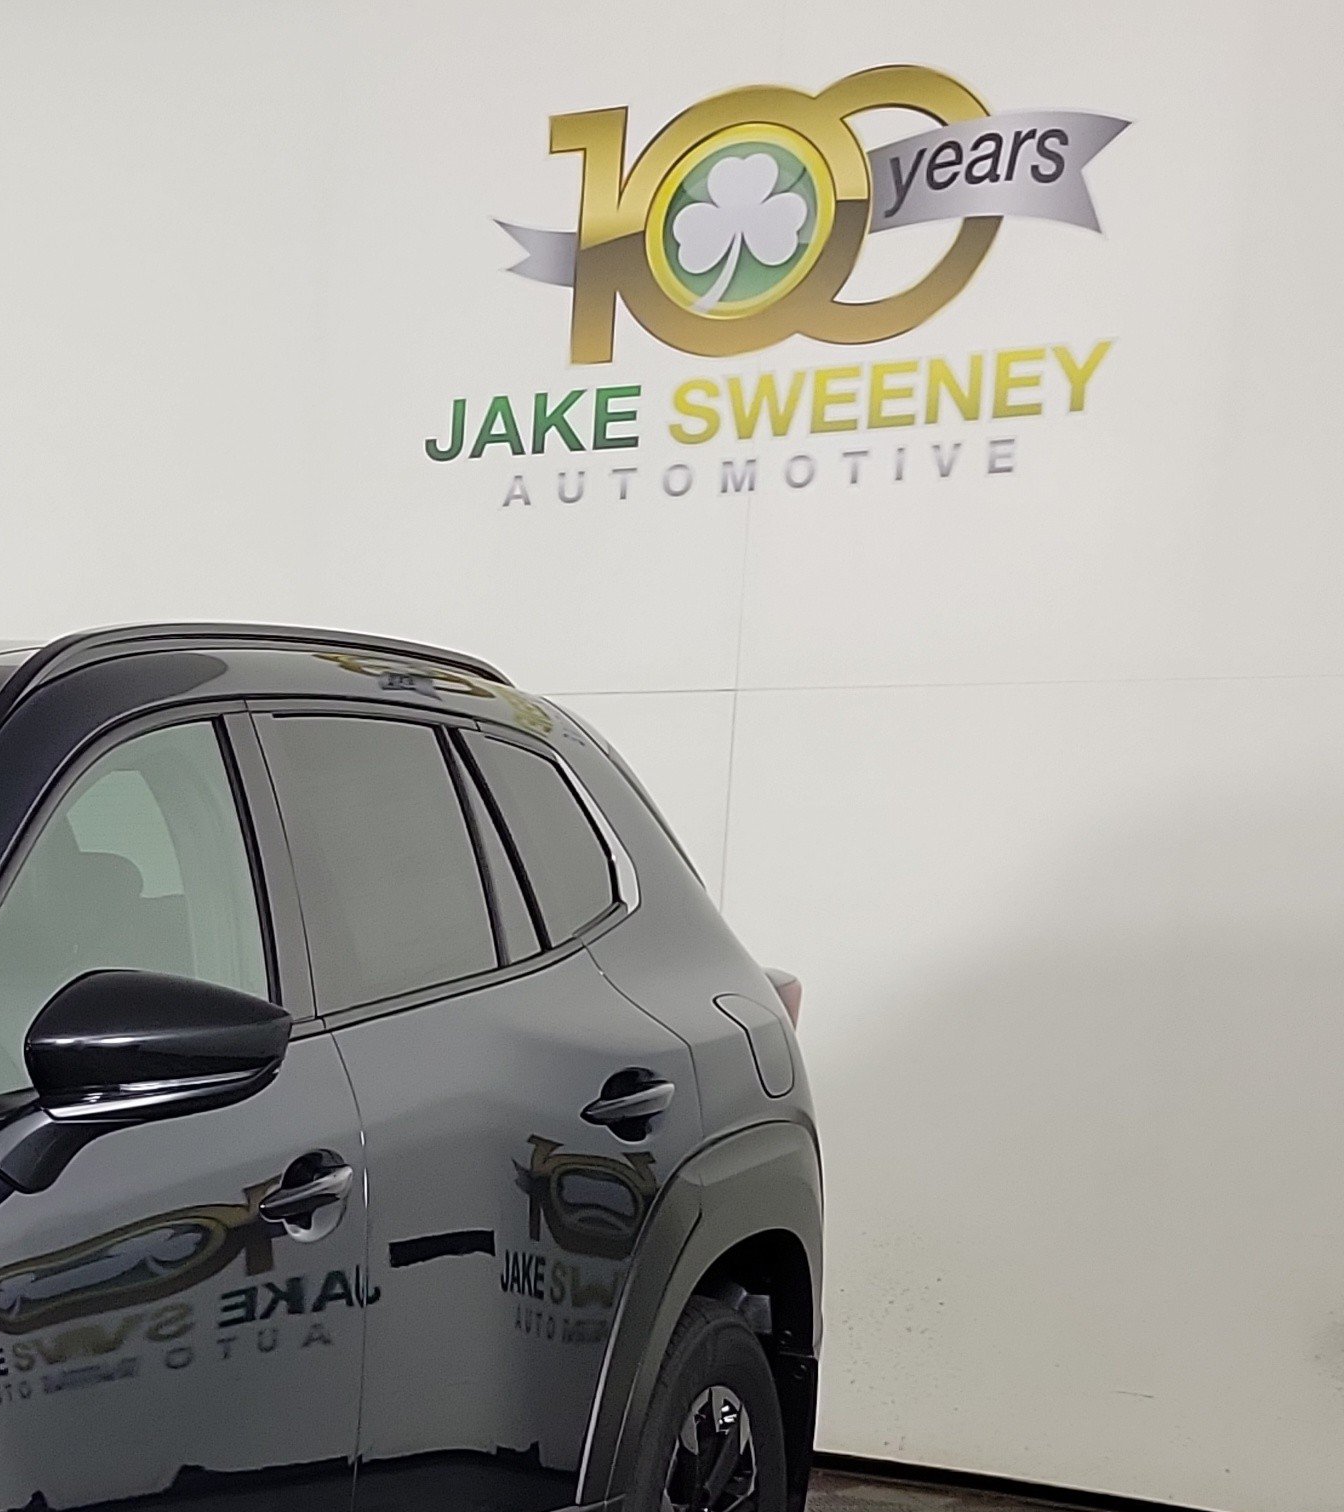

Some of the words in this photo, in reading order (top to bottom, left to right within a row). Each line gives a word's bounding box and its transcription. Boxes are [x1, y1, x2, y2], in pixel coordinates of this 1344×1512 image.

[885, 125, 1069, 216] years
[424, 384, 643, 463] JAKE
[668, 339, 1117, 445] SWEENEY
[501, 438, 1017, 508] AUTOMOTIVE
[500, 1249, 546, 1300] JAKE
